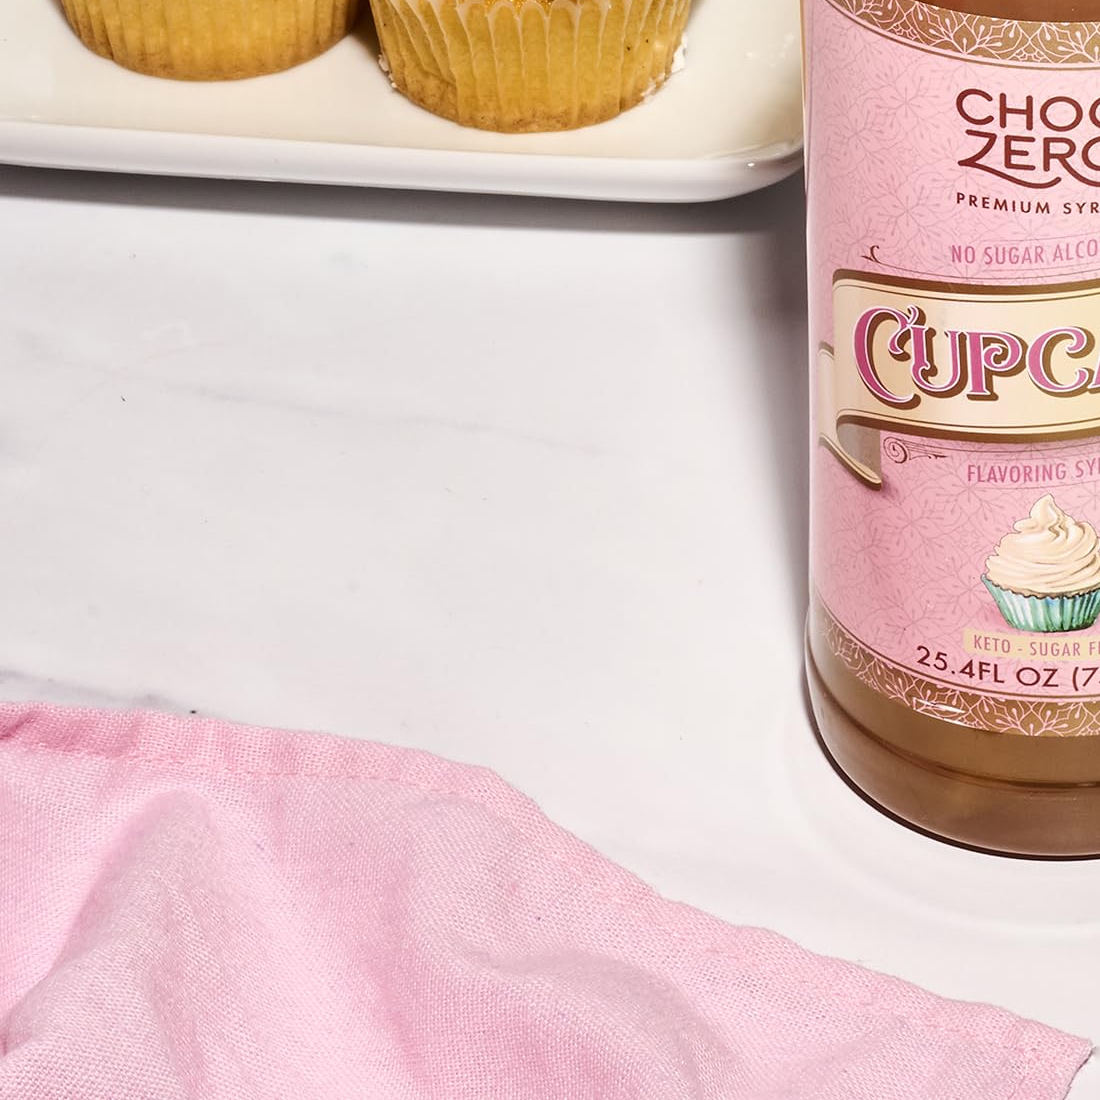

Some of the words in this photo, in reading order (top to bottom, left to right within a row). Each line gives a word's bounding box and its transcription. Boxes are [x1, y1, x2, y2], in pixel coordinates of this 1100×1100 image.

[956, 192, 1050, 214] PREMIUM
[950, 243, 976, 264] NO
[984, 242, 1045, 266] SUGAR
[967, 461, 1067, 483] FLAVORING
[973, 635, 1011, 654] KETO
[1029, 639, 1083, 657] SUGAR
[916, 646, 1005, 684] 25.4FL
[1015, 666, 1060, 688] OZ
